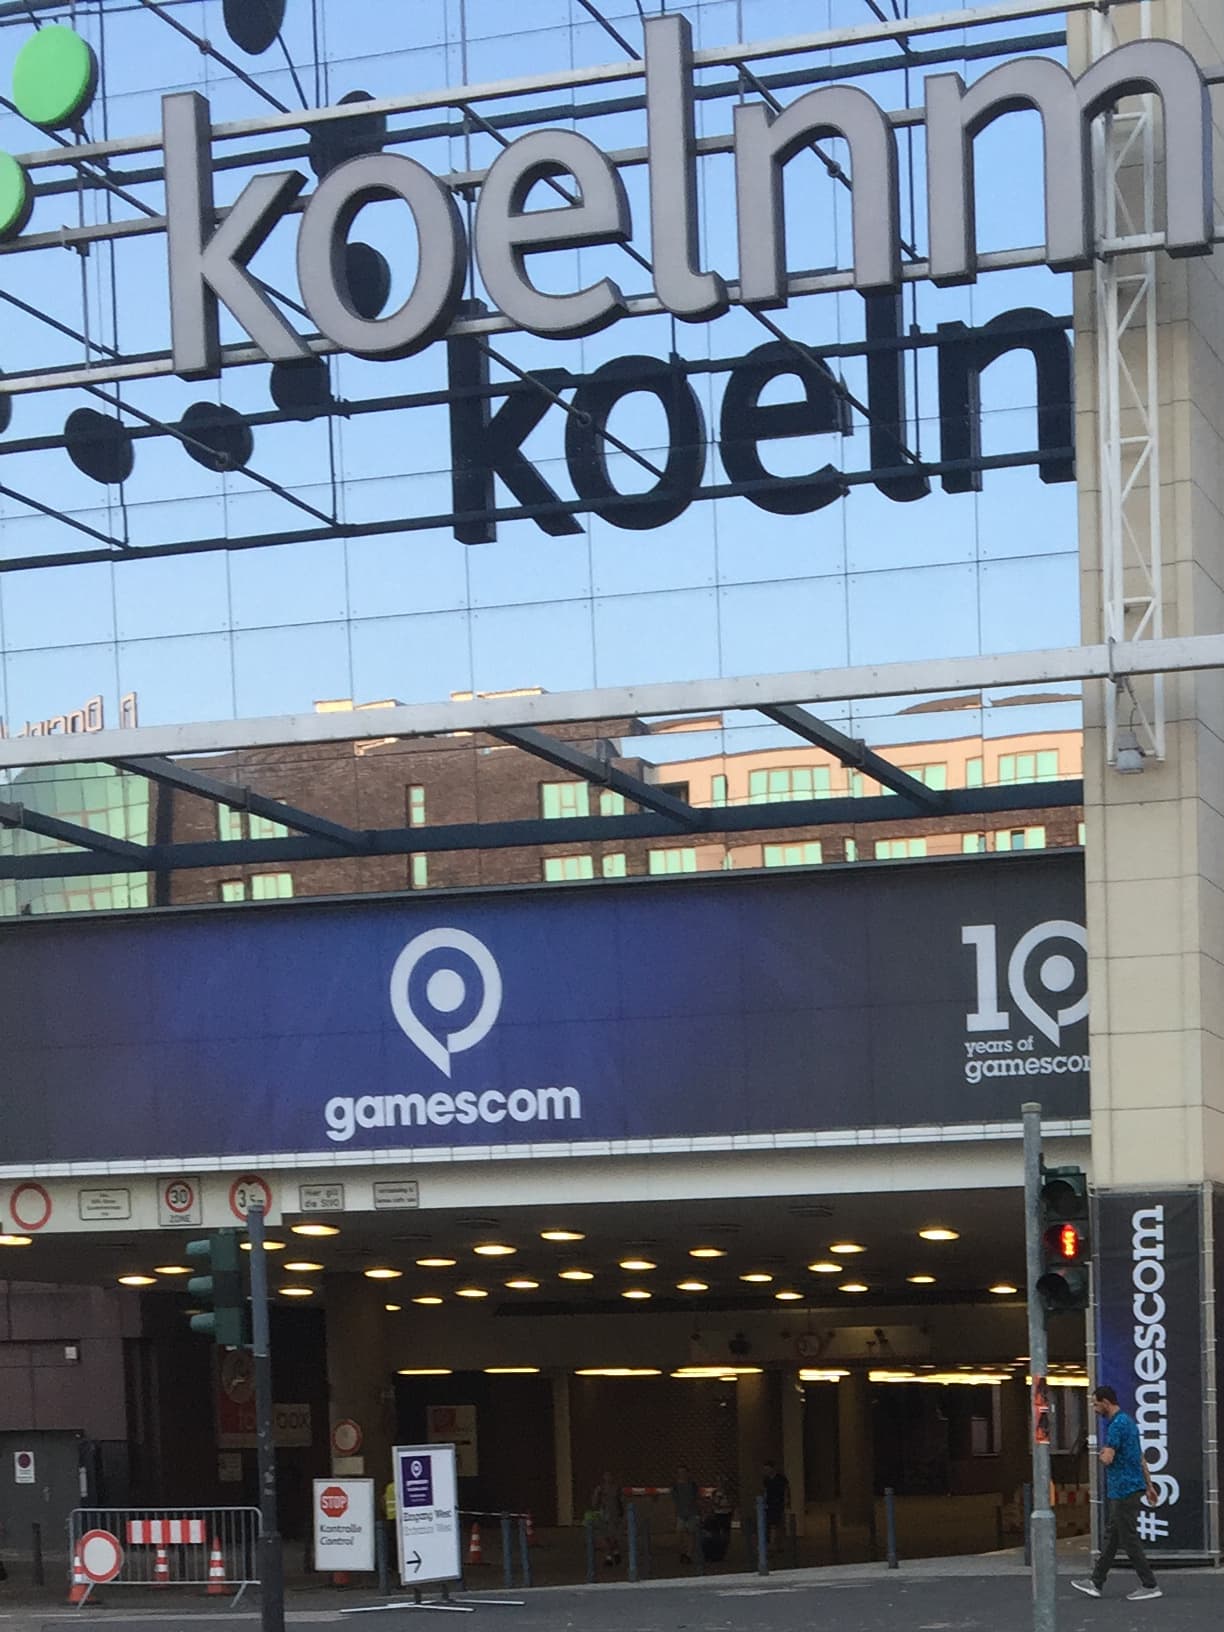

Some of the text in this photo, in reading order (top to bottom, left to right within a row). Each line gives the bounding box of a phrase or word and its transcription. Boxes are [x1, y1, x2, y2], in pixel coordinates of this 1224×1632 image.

[964, 1035, 1034, 1058] years of
[964, 1054, 1091, 1084] gamesco
[324, 1086, 581, 1142] gamescom
[171, 1190, 187, 1205] 30
[168, 1214, 191, 1223] ZONE
[1131, 1205, 1180, 1542] #gamescom
[322, 1495, 347, 1509] STOP
[319, 1523, 362, 1533] Kontrolle
[319, 1536, 355, 1546] Control
